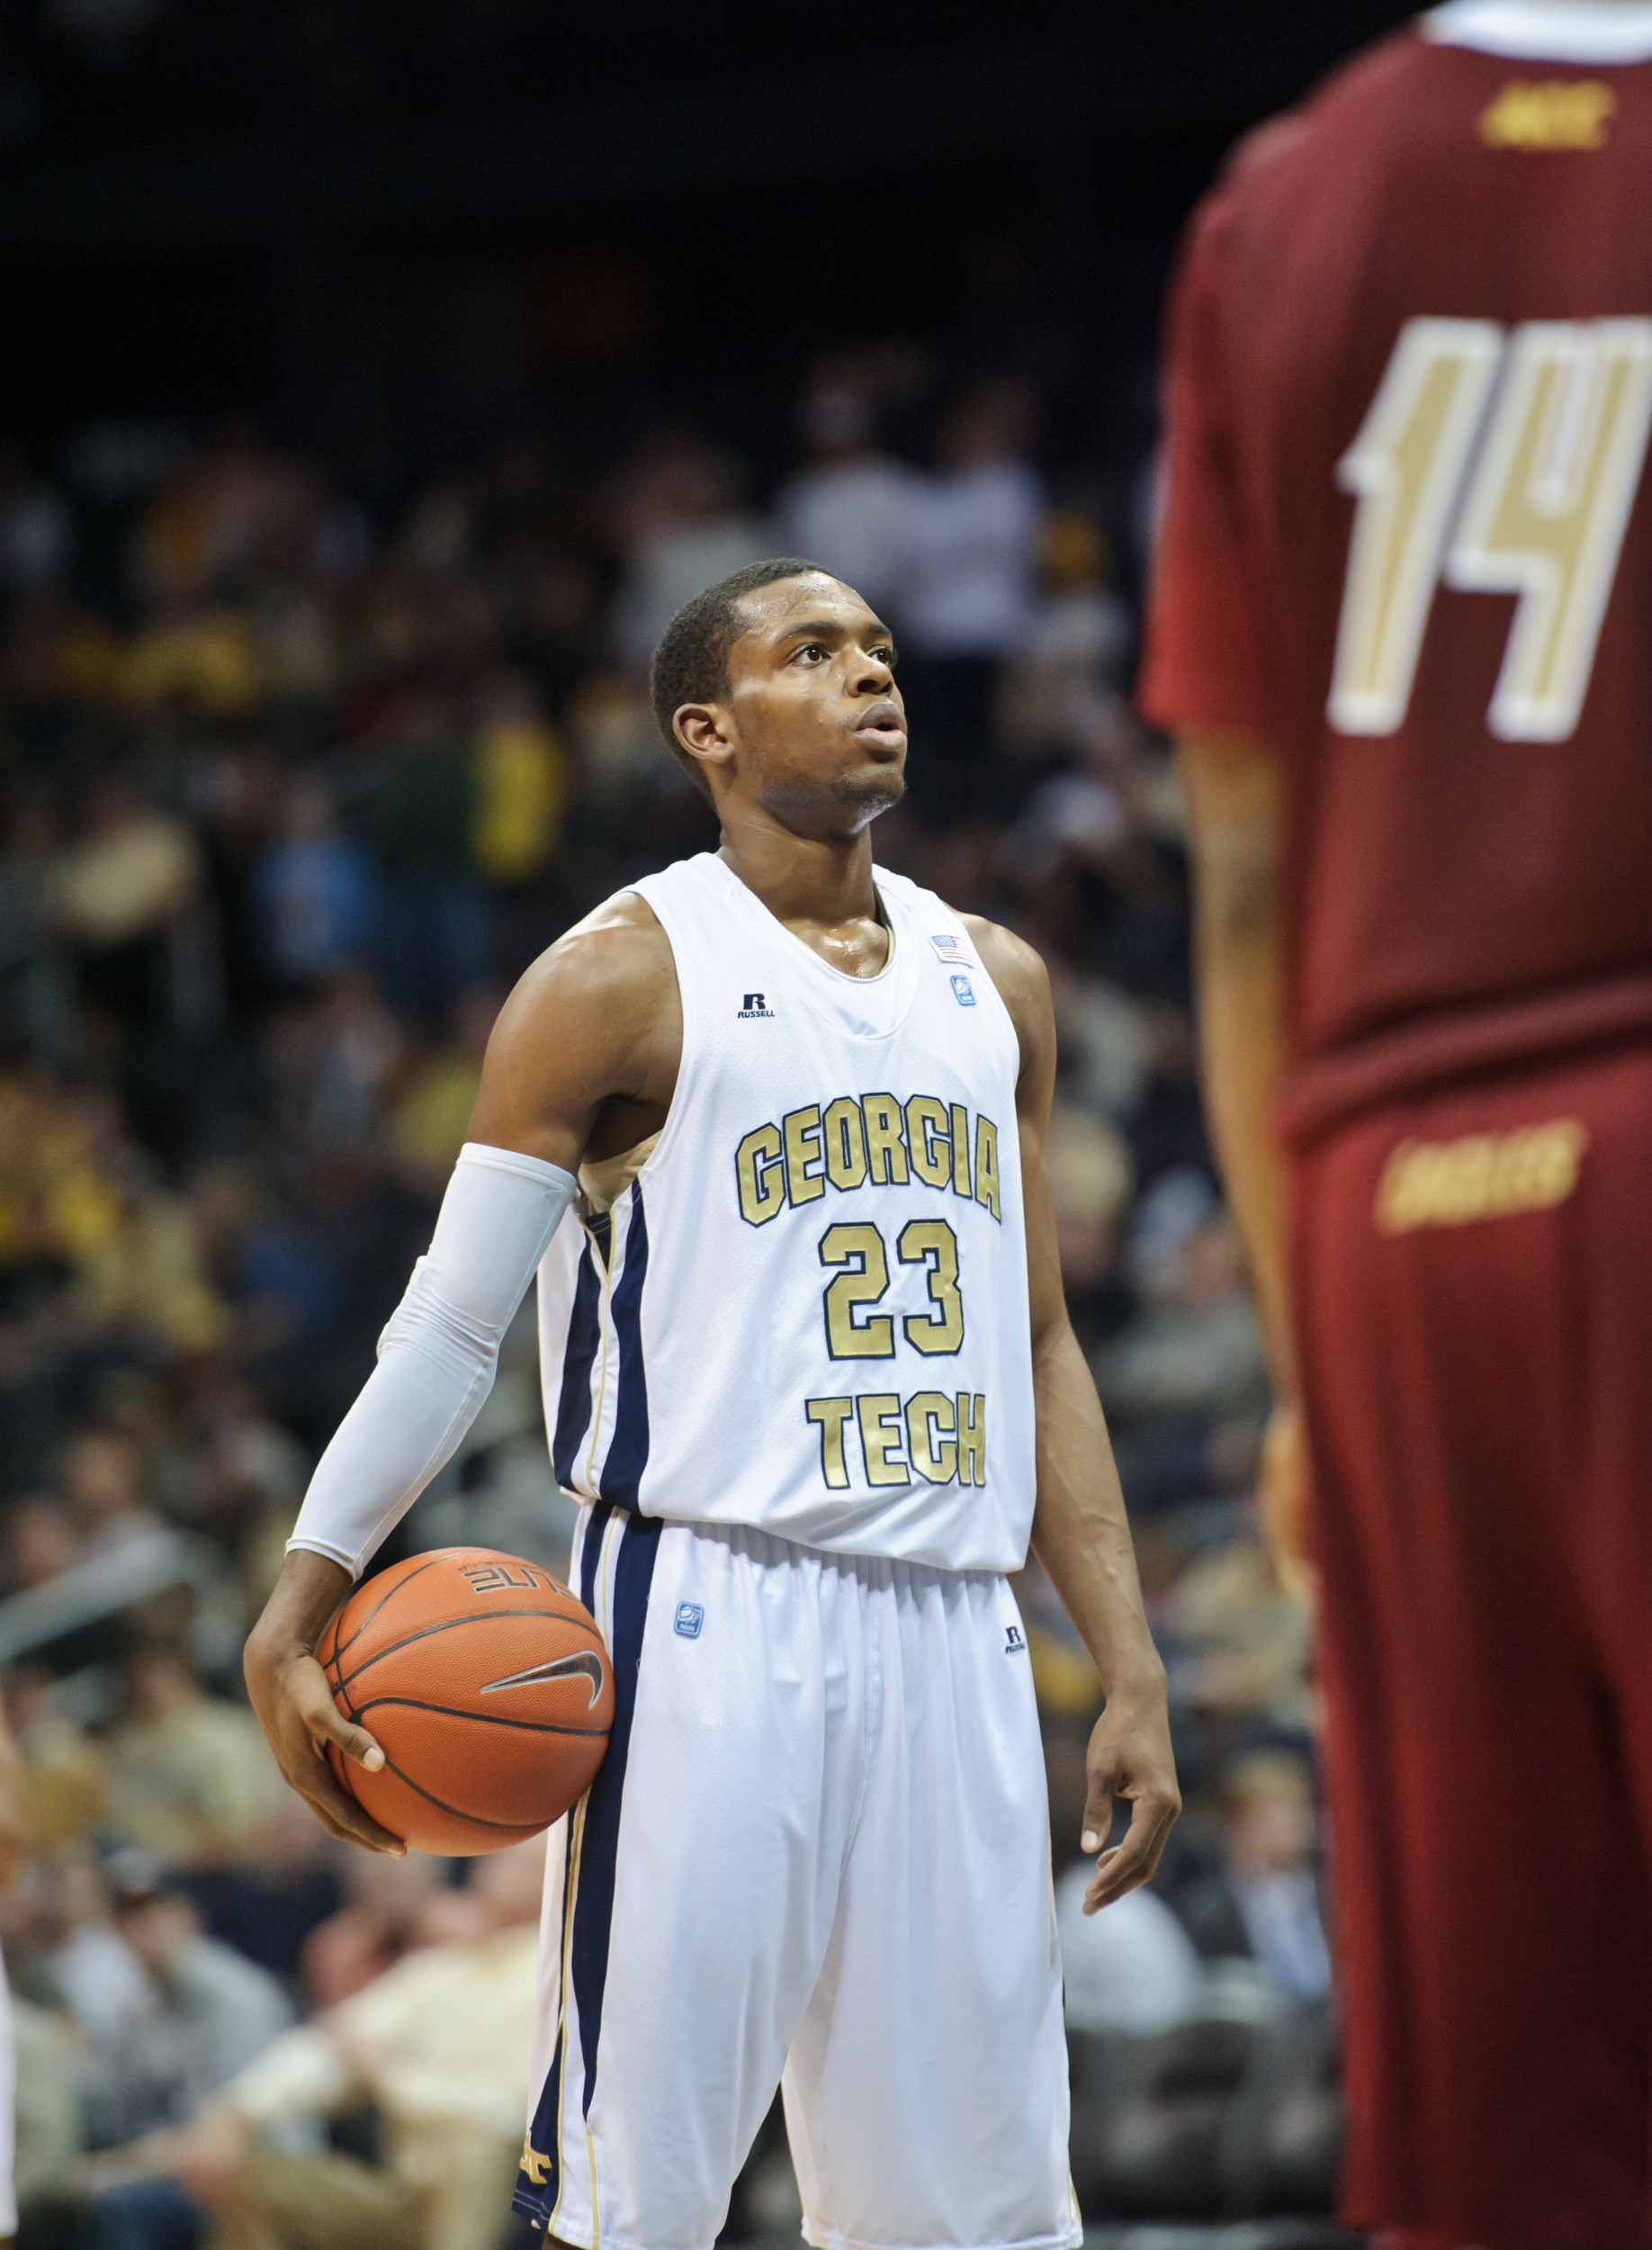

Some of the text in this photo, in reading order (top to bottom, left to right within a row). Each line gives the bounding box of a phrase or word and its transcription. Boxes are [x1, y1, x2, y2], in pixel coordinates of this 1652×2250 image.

[1326, 315, 1652, 742] 14
[737, 1010, 776, 1019] RUSSELL
[743, 993, 766, 1010] R
[735, 1092, 1002, 1228] GEORGIA
[818, 1219, 965, 1361] 23
[804, 1390, 986, 1490] TECH
[1005, 1625, 1021, 1643] R
